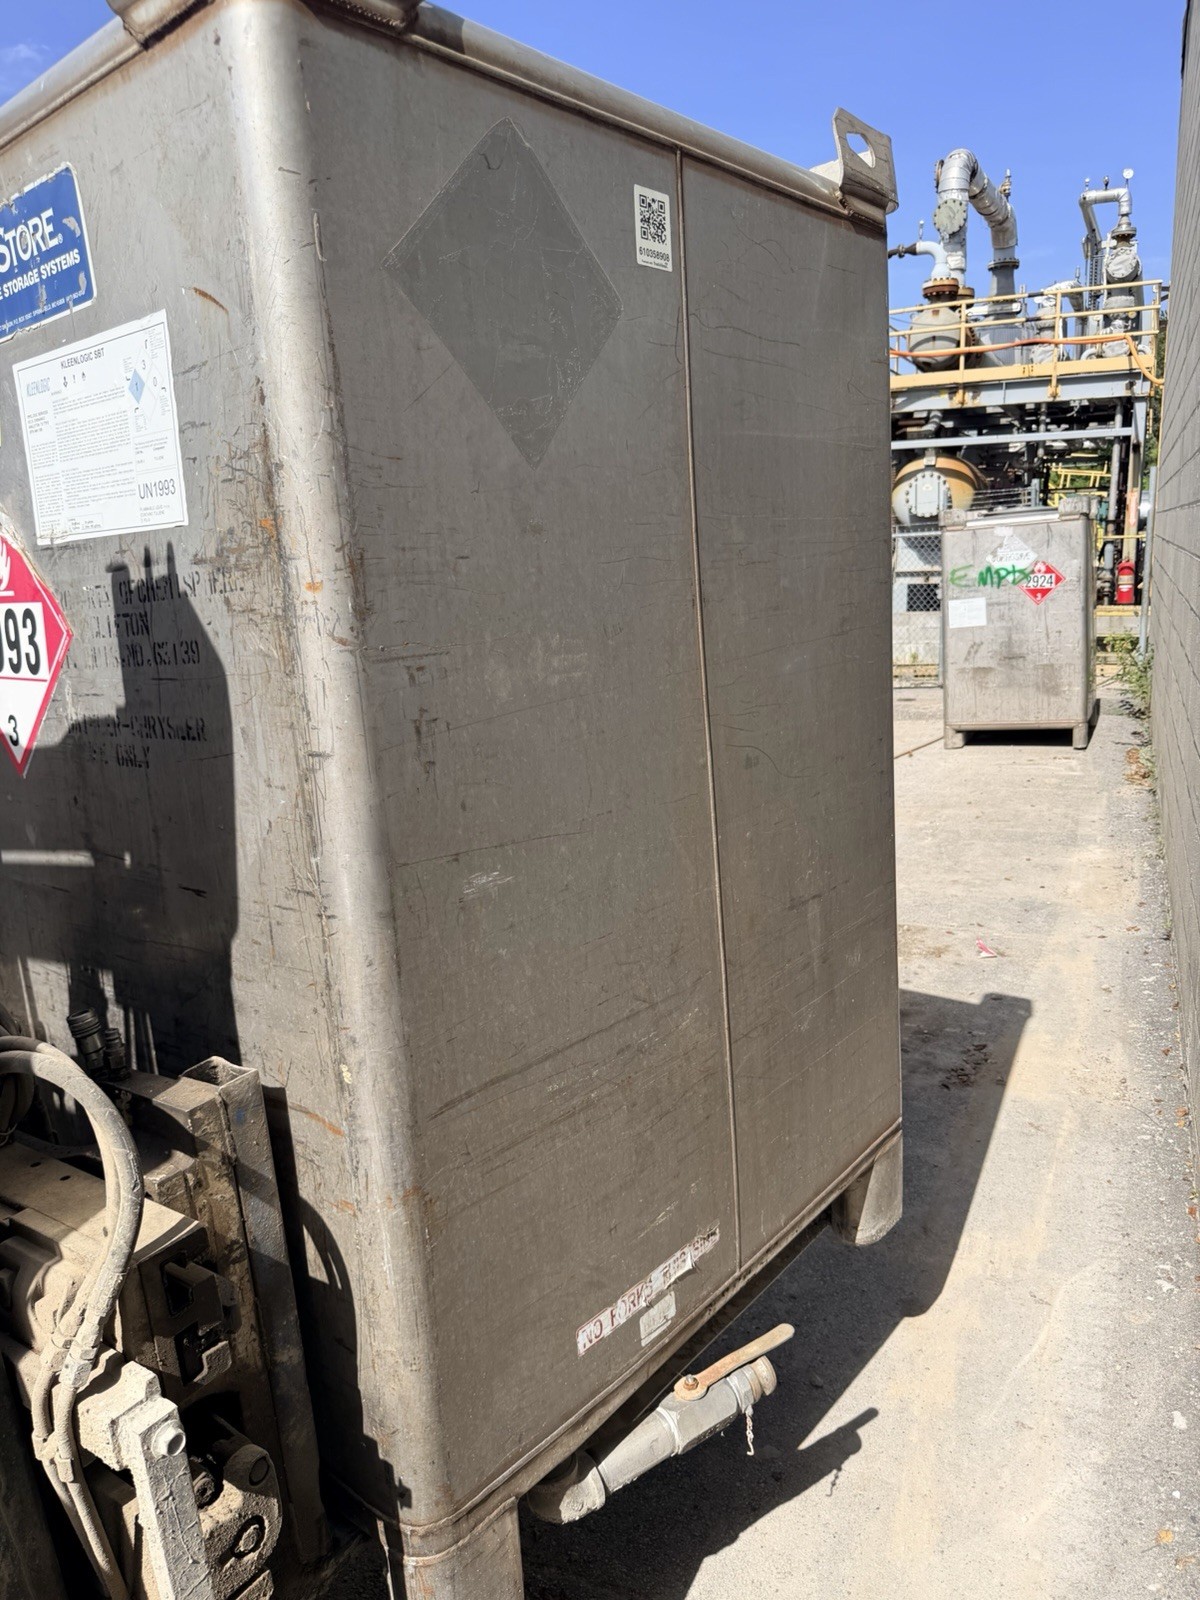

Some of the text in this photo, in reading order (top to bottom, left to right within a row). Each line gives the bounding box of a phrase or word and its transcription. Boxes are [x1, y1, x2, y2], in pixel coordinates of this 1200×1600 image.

[3, 269, 39, 298] STORAGE
[40, 248, 81, 280] SYSTEMS
[60, 347, 105, 370] KLEENLOGIC SBT
[137, 478, 176, 500] UN1993
[1025, 574, 1054, 588] 2924
[0, 608, 41, 676] 93
[7, 714, 20, 747] 3
[582, 1317, 603, 1349] NO
